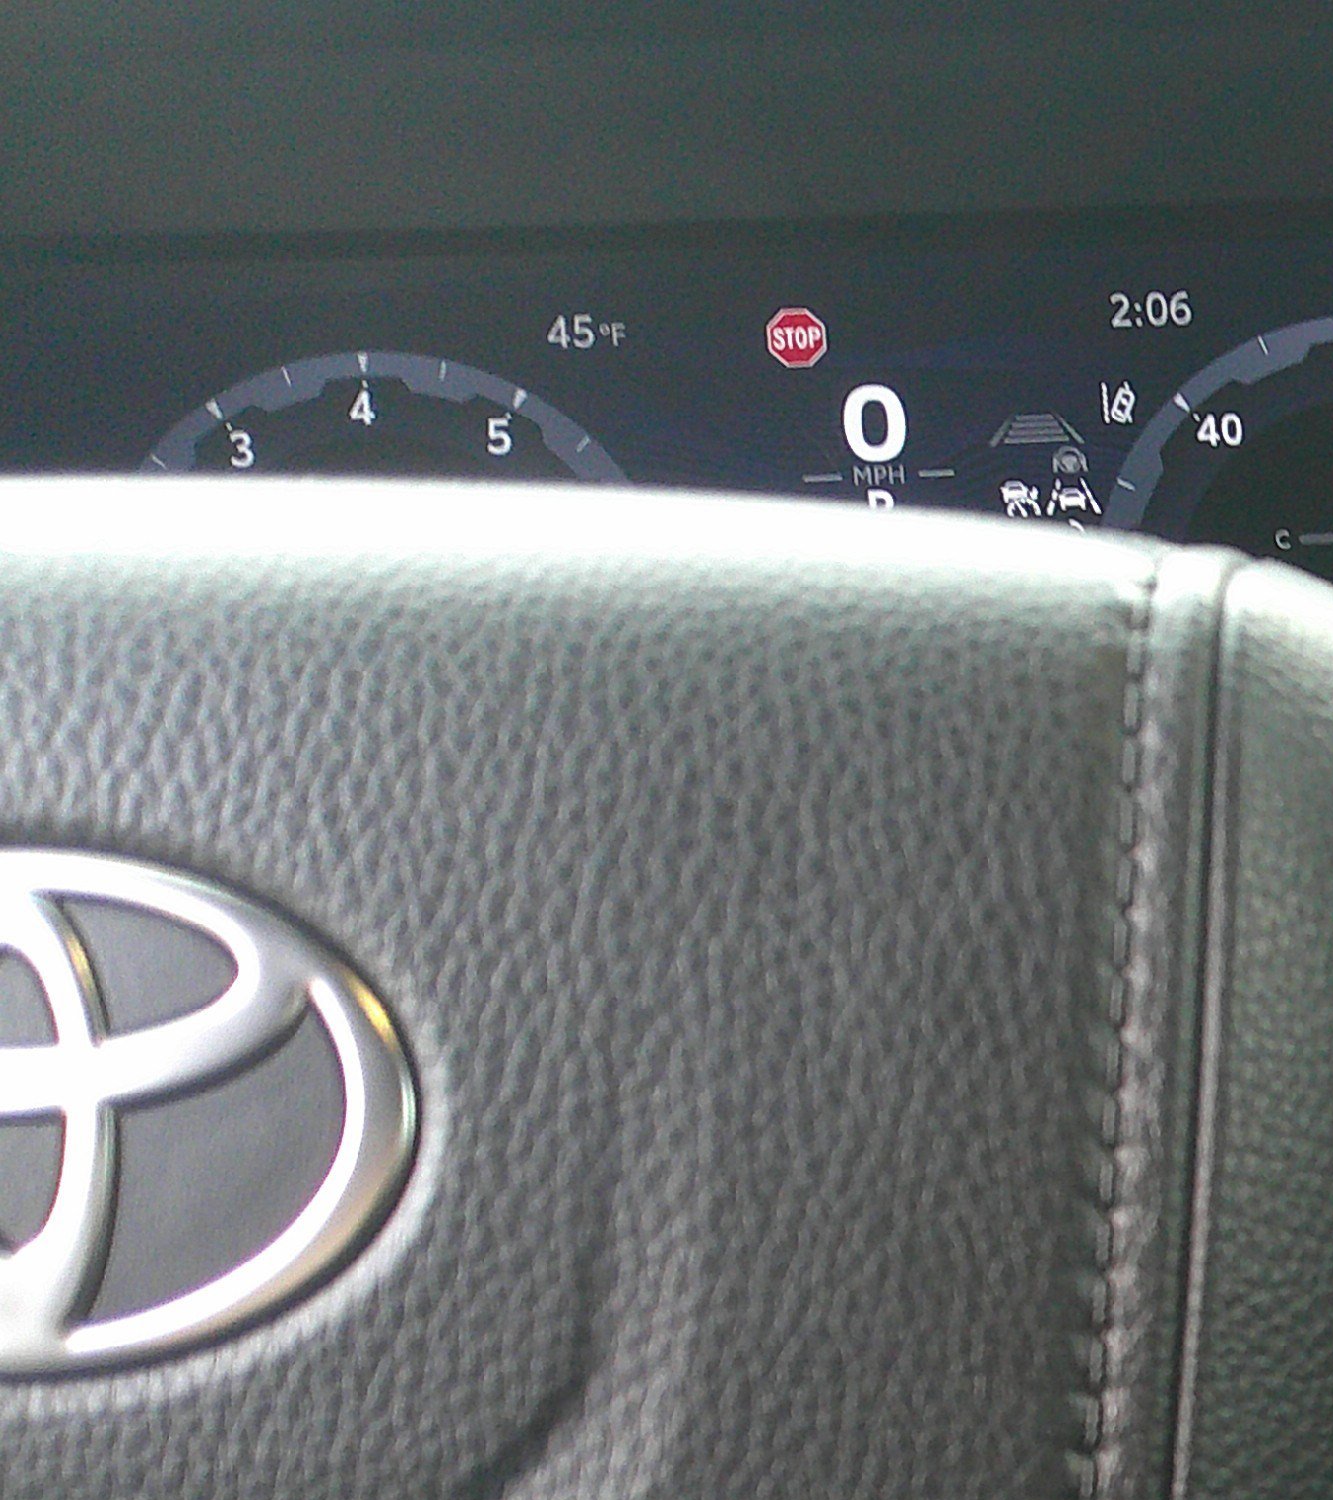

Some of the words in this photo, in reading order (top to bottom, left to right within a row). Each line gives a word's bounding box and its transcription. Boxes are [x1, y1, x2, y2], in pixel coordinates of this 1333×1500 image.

[1110, 291, 1192, 328] 2:06
[773, 327, 821, 351] STOP
[350, 391, 375, 426] 4
[843, 385, 906, 463] 0
[487, 419, 512, 455] 5
[1196, 414, 1242, 446] 40
[230, 430, 254, 468] 3
[853, 464, 905, 486] MPH
[1275, 529, 1292, 550] C
